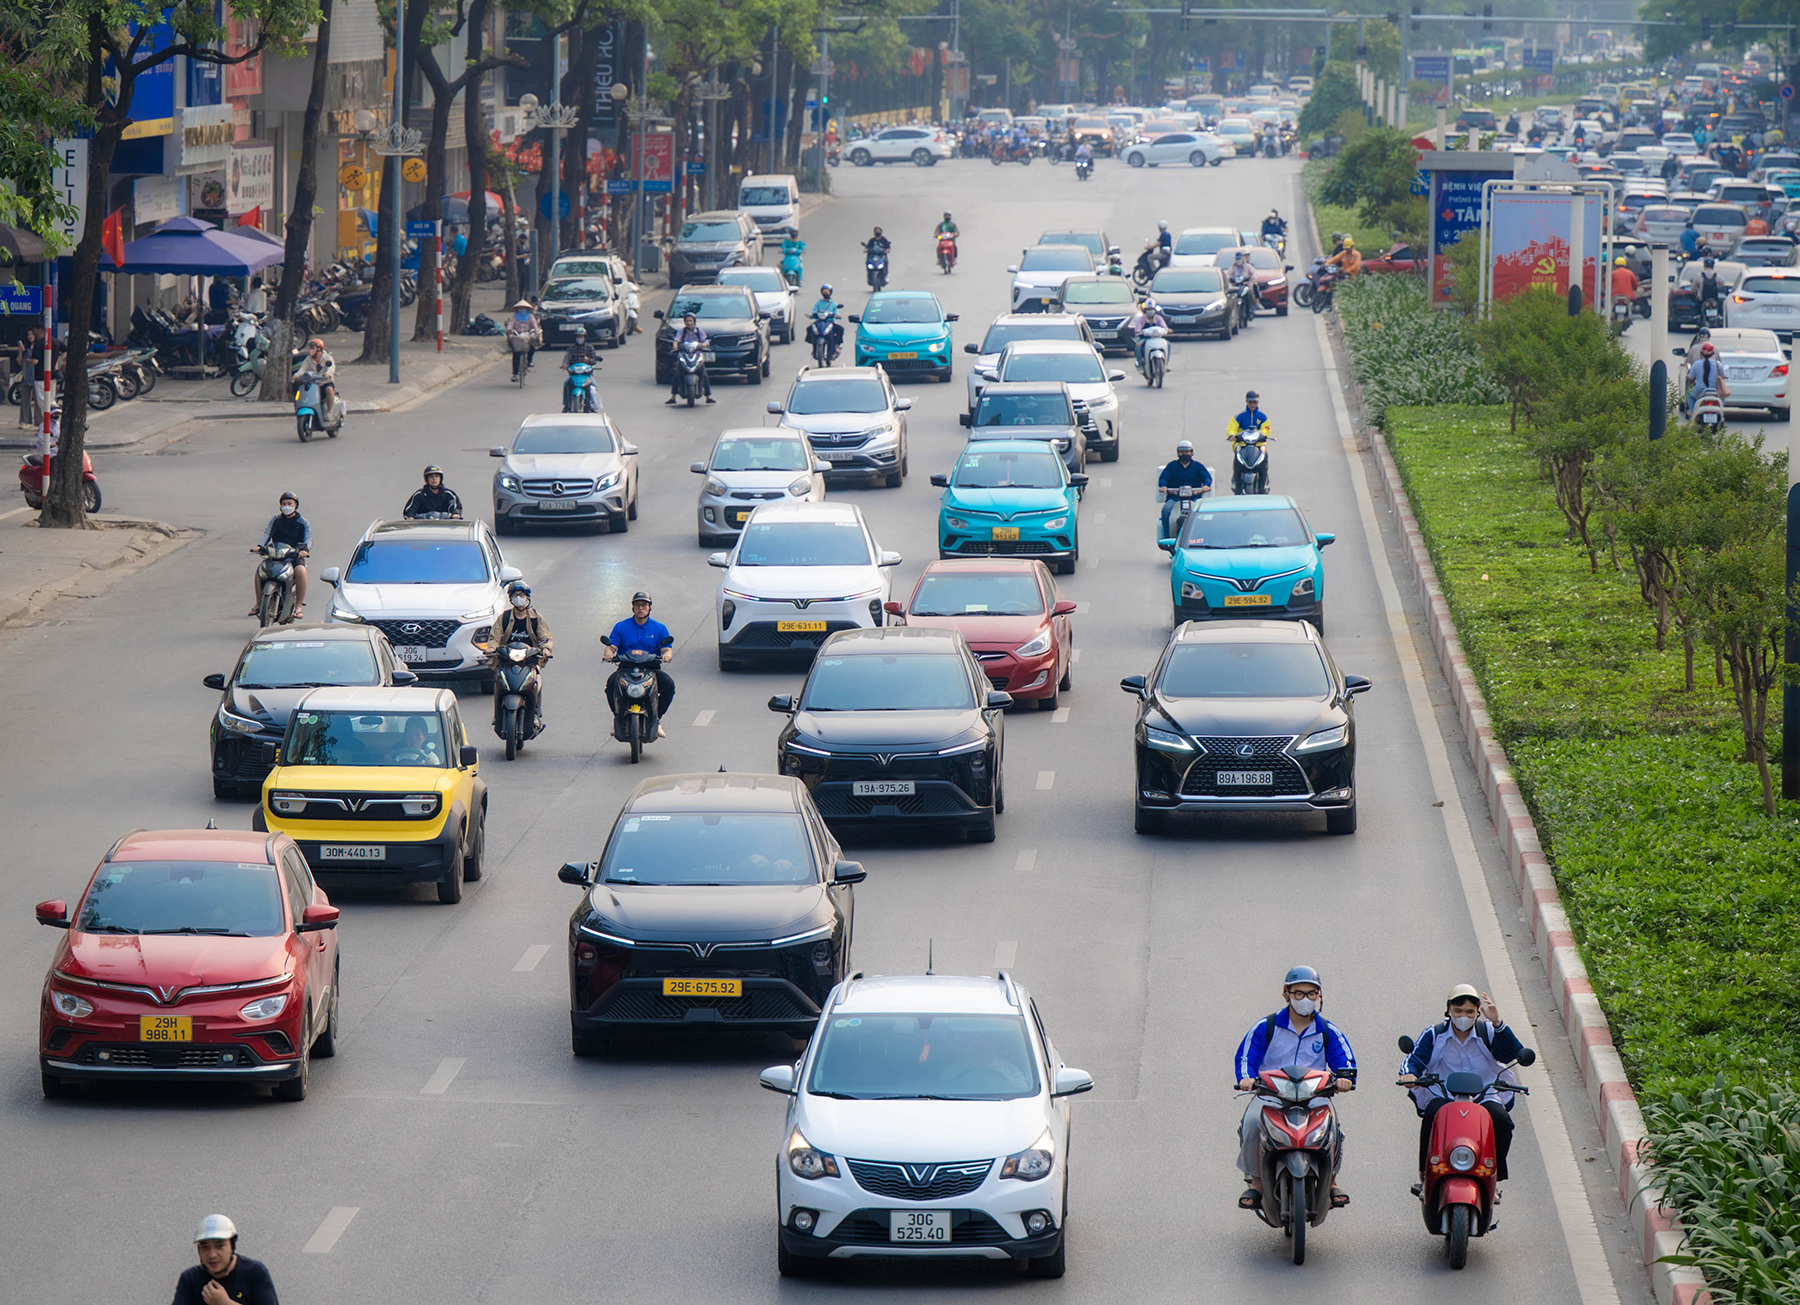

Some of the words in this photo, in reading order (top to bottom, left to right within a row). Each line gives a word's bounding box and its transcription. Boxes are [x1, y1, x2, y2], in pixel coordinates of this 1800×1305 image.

[1468, 182, 1482, 192] VIỆ
[10, 302, 32, 311] QUANG
[1228, 596, 1268, 605] 29E-594.92
[781, 622, 822, 631] 29E-631.11
[1218, 773, 1272, 784] 89A-196.88
[859, 783, 910, 793] 19A-975.26
[326, 848, 380, 858] 30M-440.13
[670, 981, 735, 994] 29E-675.92
[155, 1017, 177, 1028] 29H
[146, 1029, 185, 1040] 988.11
[907, 1213, 933, 1225] 30G
[897, 1227, 944, 1240] 525.40
